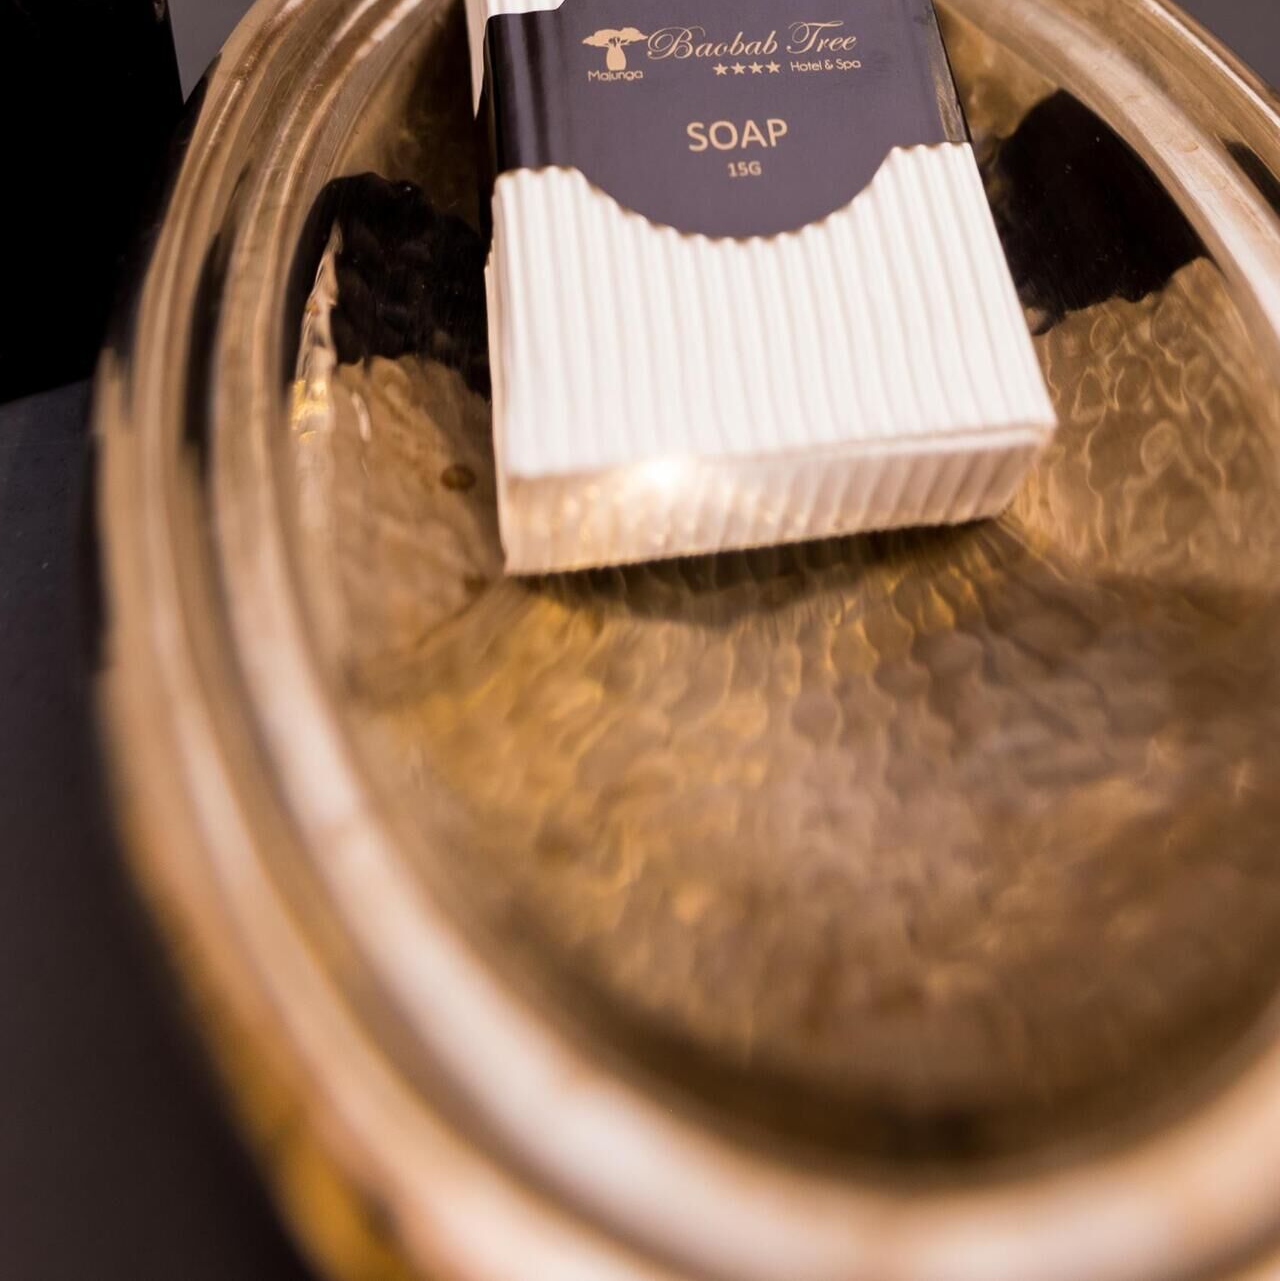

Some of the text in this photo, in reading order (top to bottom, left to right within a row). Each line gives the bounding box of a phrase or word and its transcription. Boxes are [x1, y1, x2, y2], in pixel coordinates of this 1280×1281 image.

[647, 20, 857, 60] Baobab Tree
[790, 58, 861, 72] Hotel & Spa
[587, 69, 644, 82] Majunga
[686, 118, 788, 151] SOAP
[728, 161, 762, 178] 15G
